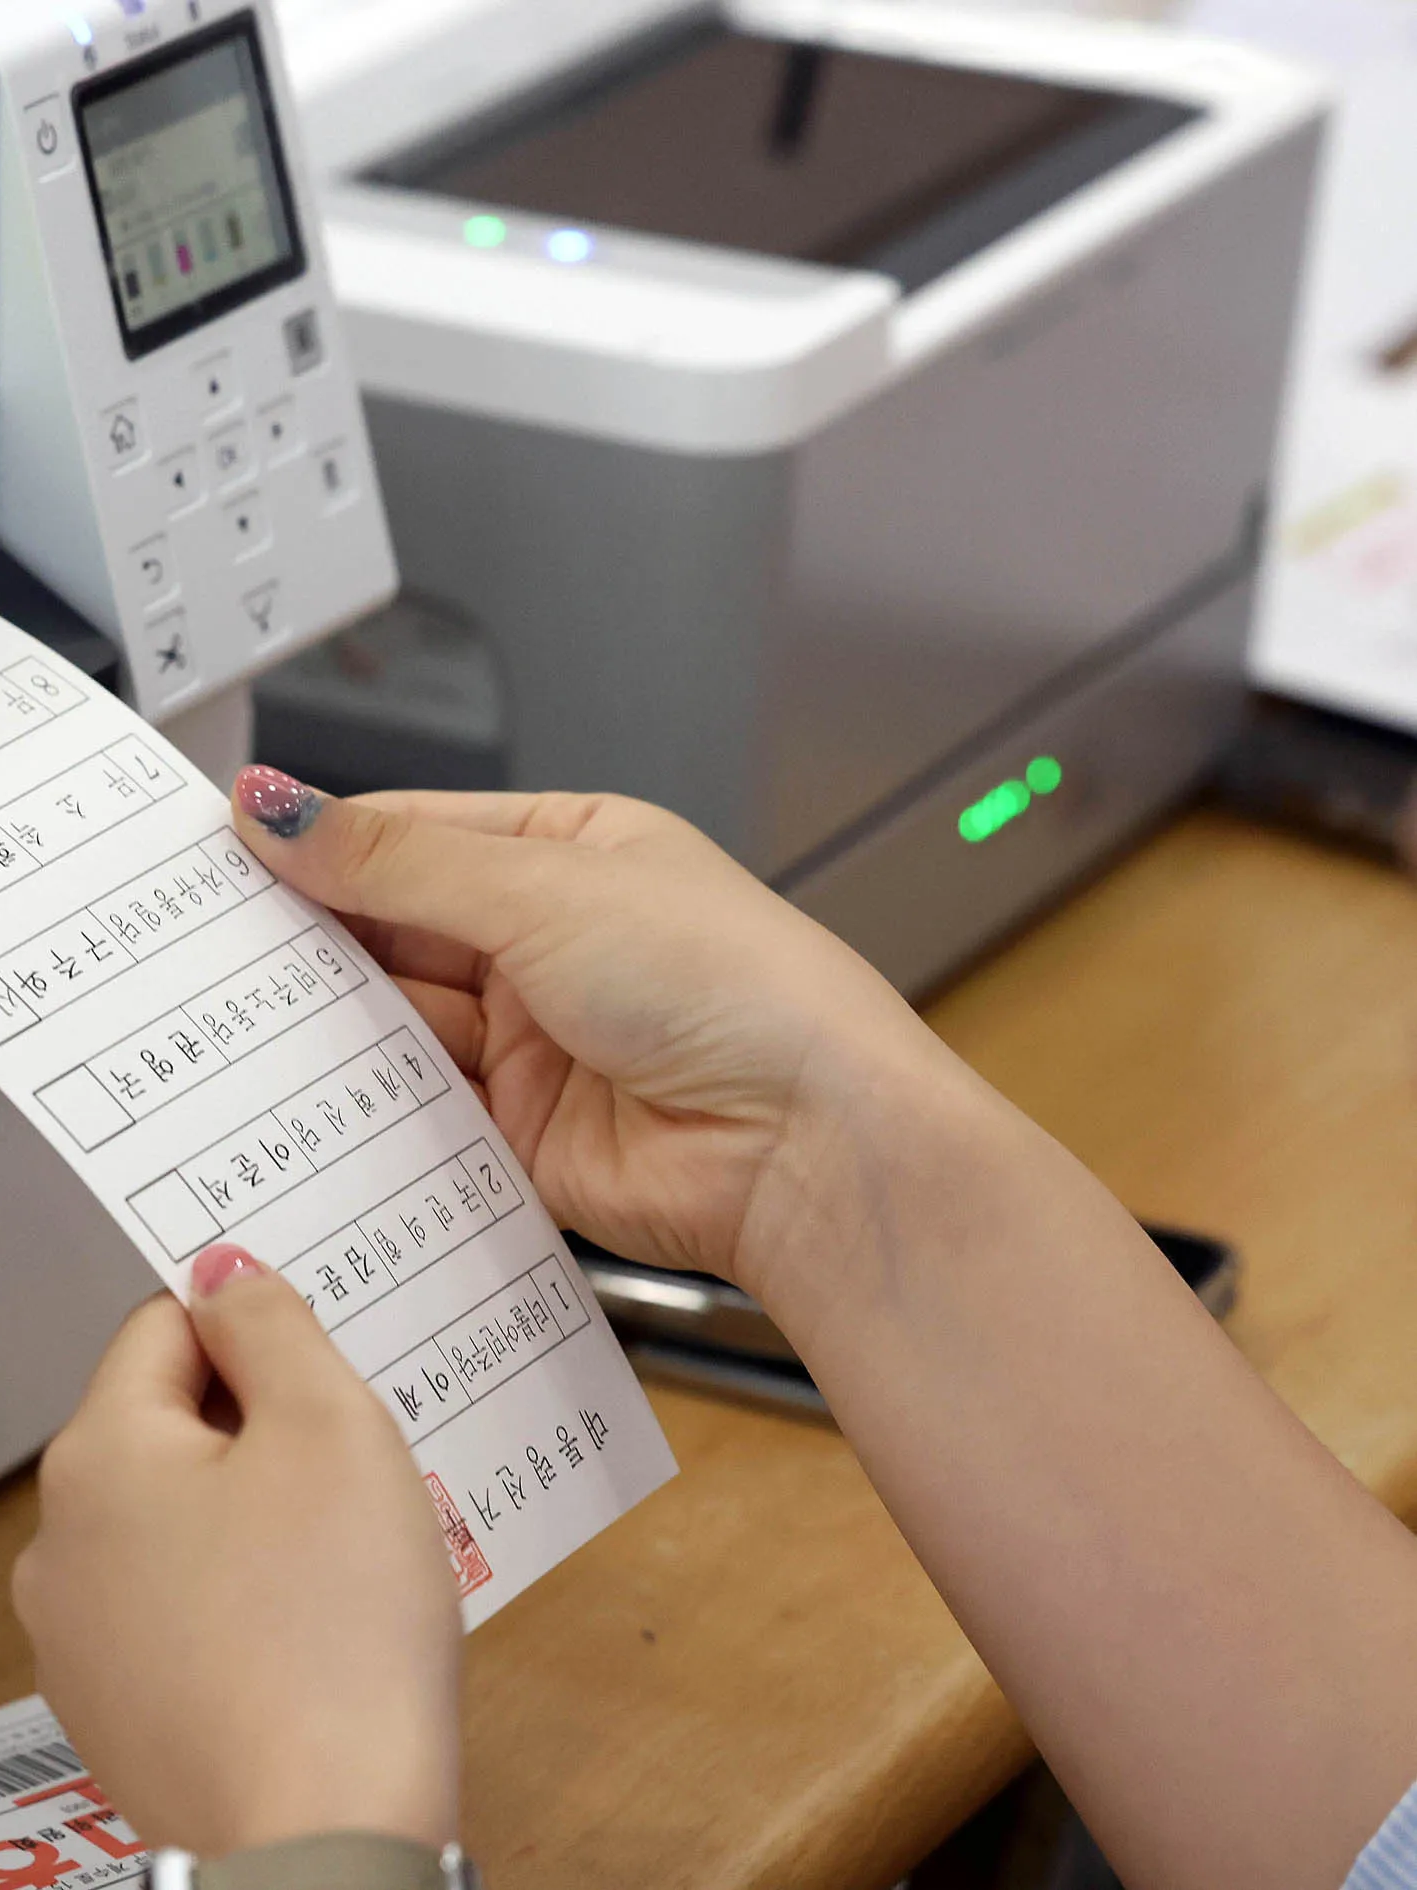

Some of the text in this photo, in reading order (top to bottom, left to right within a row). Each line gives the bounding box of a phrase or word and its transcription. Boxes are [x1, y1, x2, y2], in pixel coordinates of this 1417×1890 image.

[30, 675, 59, 696] 8
[134, 755, 160, 780] 7
[225, 850, 250, 876] 6
[109, 867, 223, 944] 자유통일당
[13, 931, 113, 998] 구주와
[109, 948, 343, 1099] 5 민주노동당 권영국
[198, 1053, 423, 1209] 4 개혁신당 이준석
[479, 1163, 502, 1194] 2
[373, 1179, 481, 1266] 국민의힘
[392, 1281, 569, 1421] 1 더불어민주당 이재
